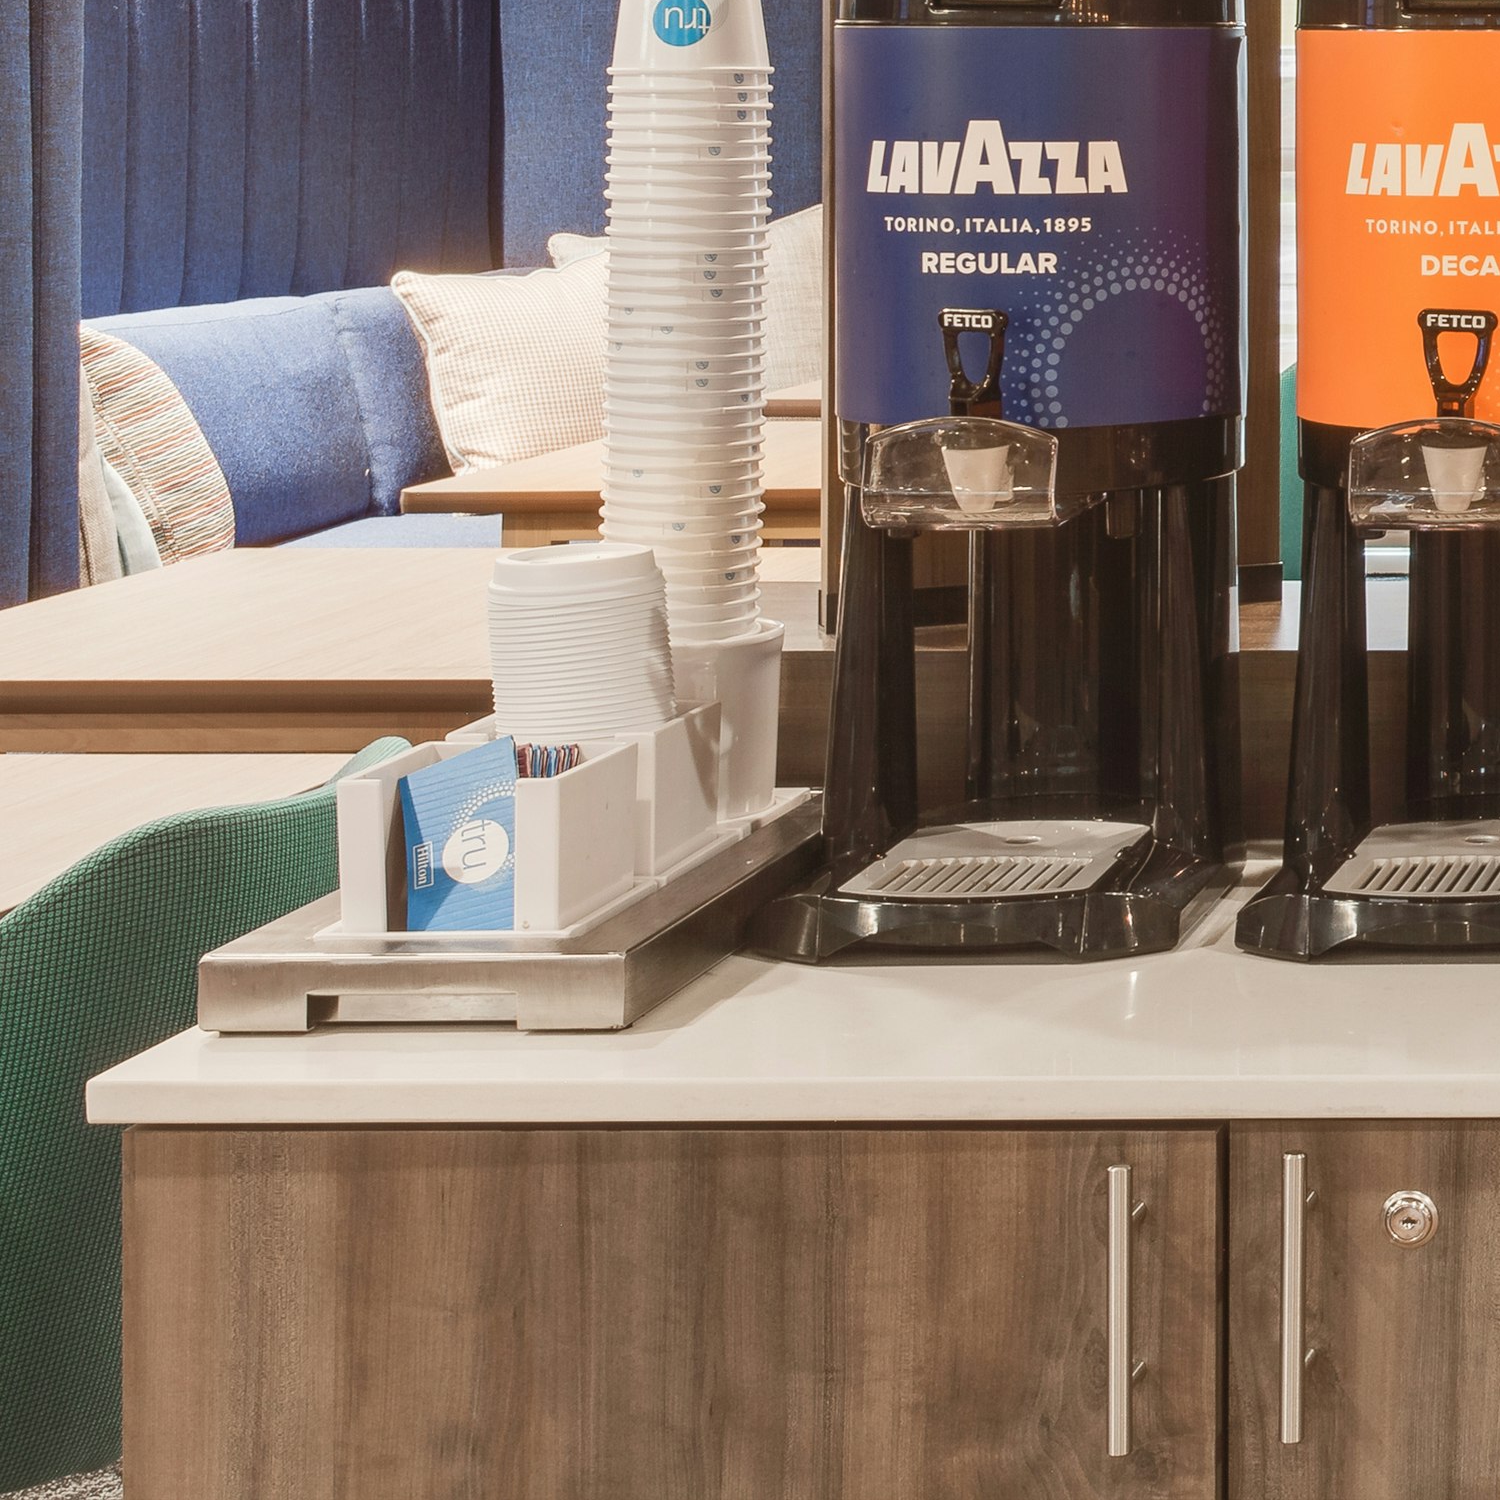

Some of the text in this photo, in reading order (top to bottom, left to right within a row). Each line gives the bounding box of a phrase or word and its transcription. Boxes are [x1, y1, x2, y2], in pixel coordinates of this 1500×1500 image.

[663, 6, 711, 34] tru
[866, 119, 1129, 195] LAVAZZA
[884, 215, 1093, 235] TORINO, ITALIA, 1895
[1365, 218, 1443, 237] TORINO,
[921, 251, 1058, 274] REGULAR
[943, 314, 993, 329] FETCO
[1426, 314, 1486, 330] FETCO
[461, 819, 493, 871] tru
[416, 845, 430, 886] Hilton
